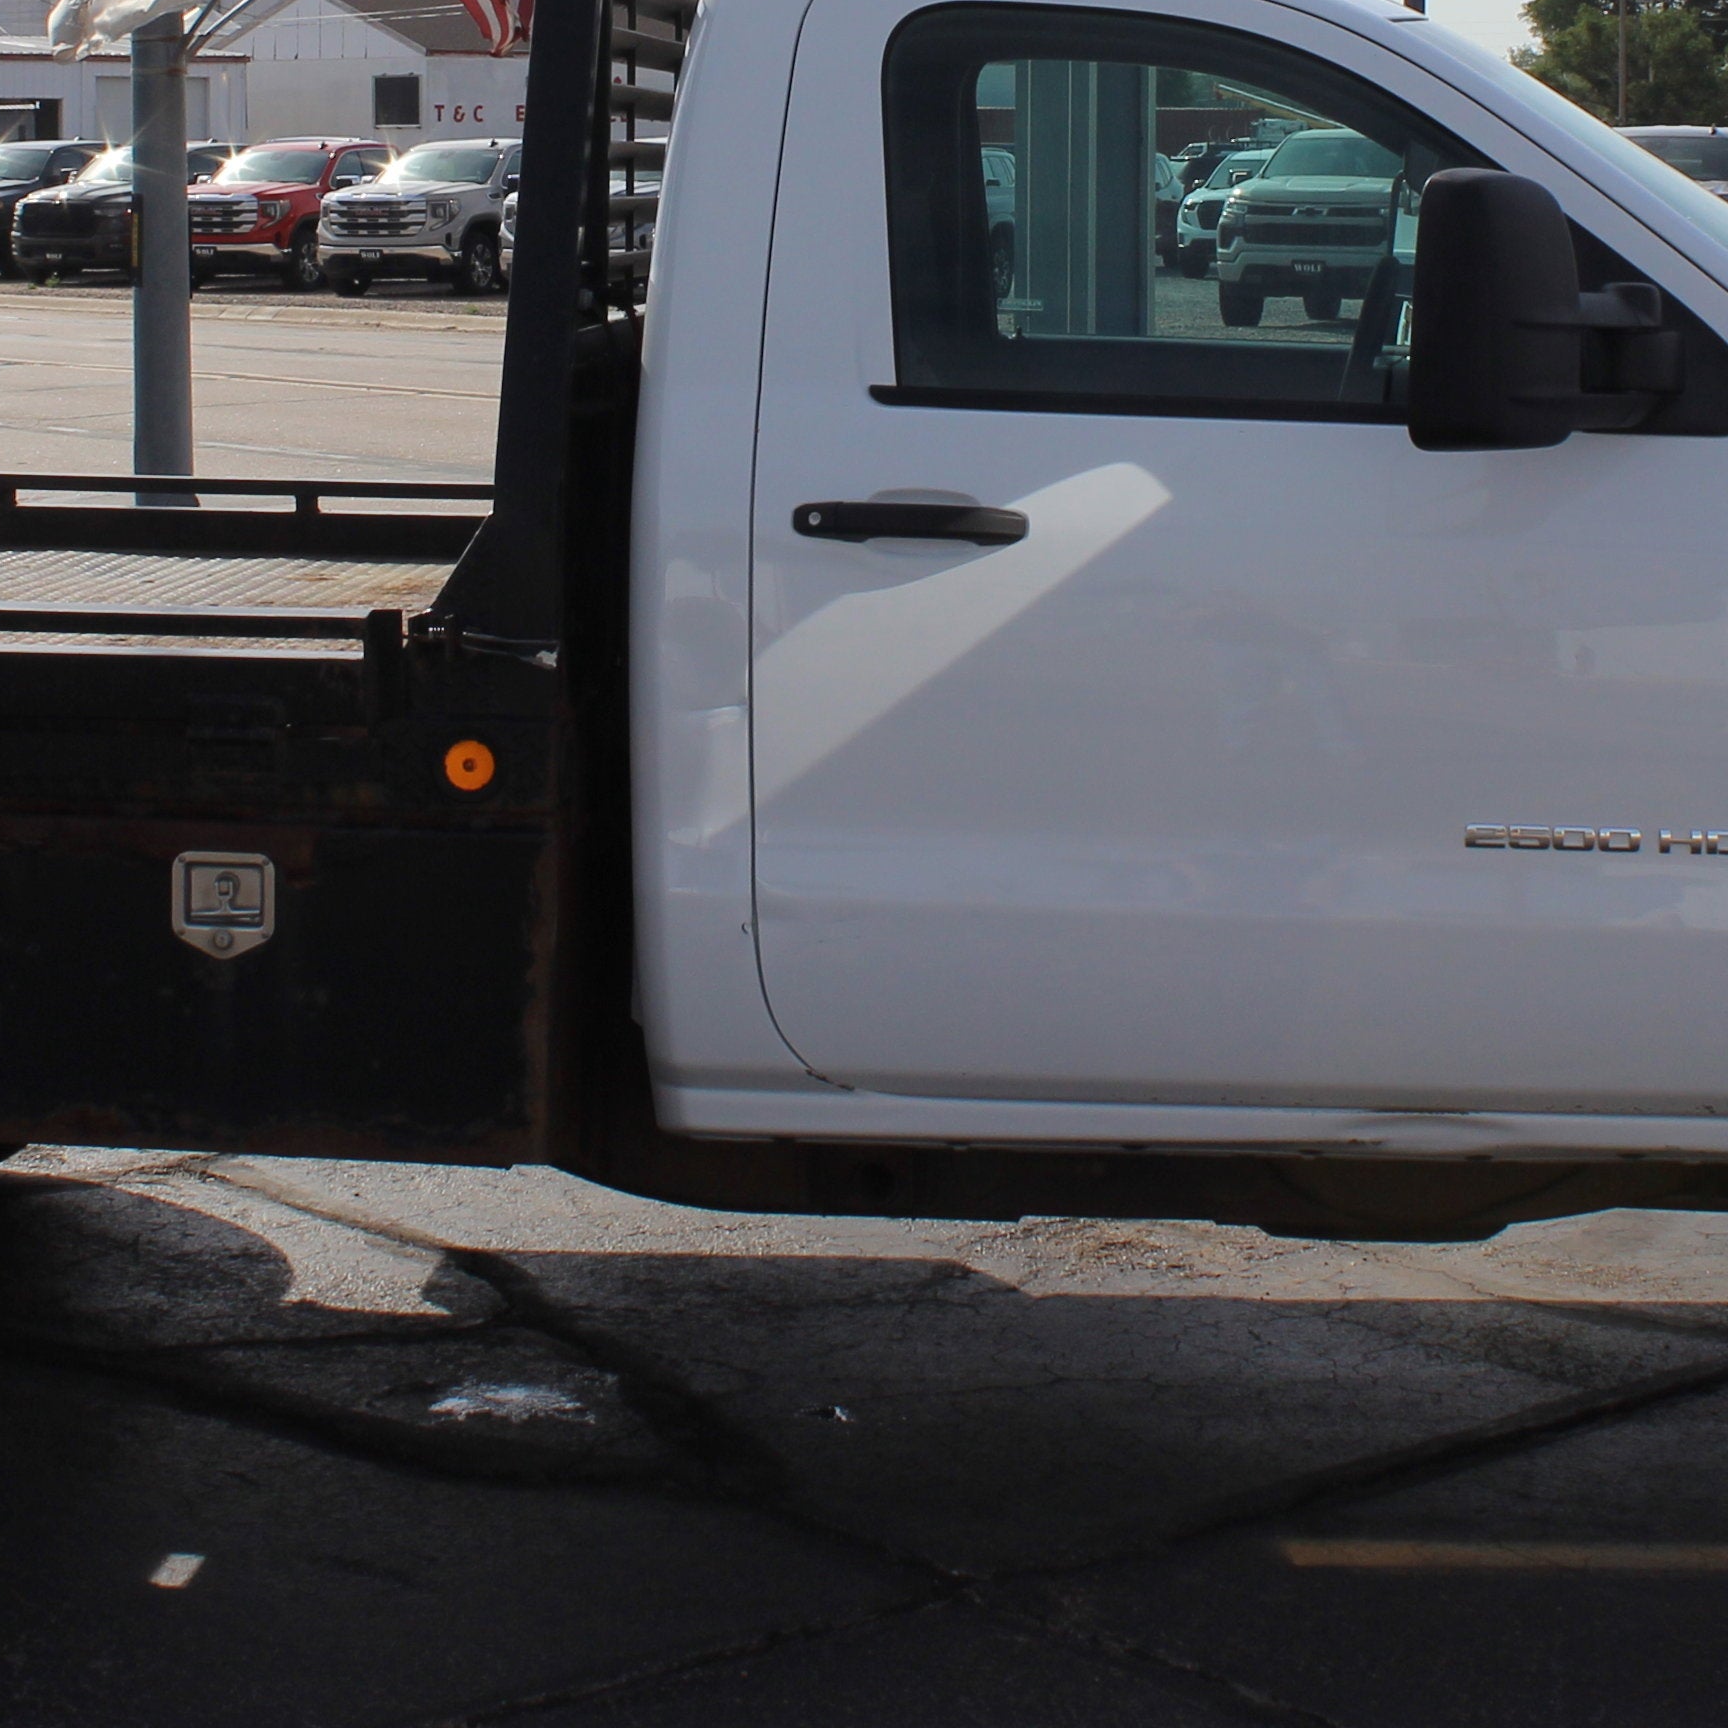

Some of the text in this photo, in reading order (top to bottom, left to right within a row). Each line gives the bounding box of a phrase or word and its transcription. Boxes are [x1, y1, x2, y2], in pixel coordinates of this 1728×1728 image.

[434, 105, 484, 123] T & C
[1465, 823, 1644, 853] 2500
